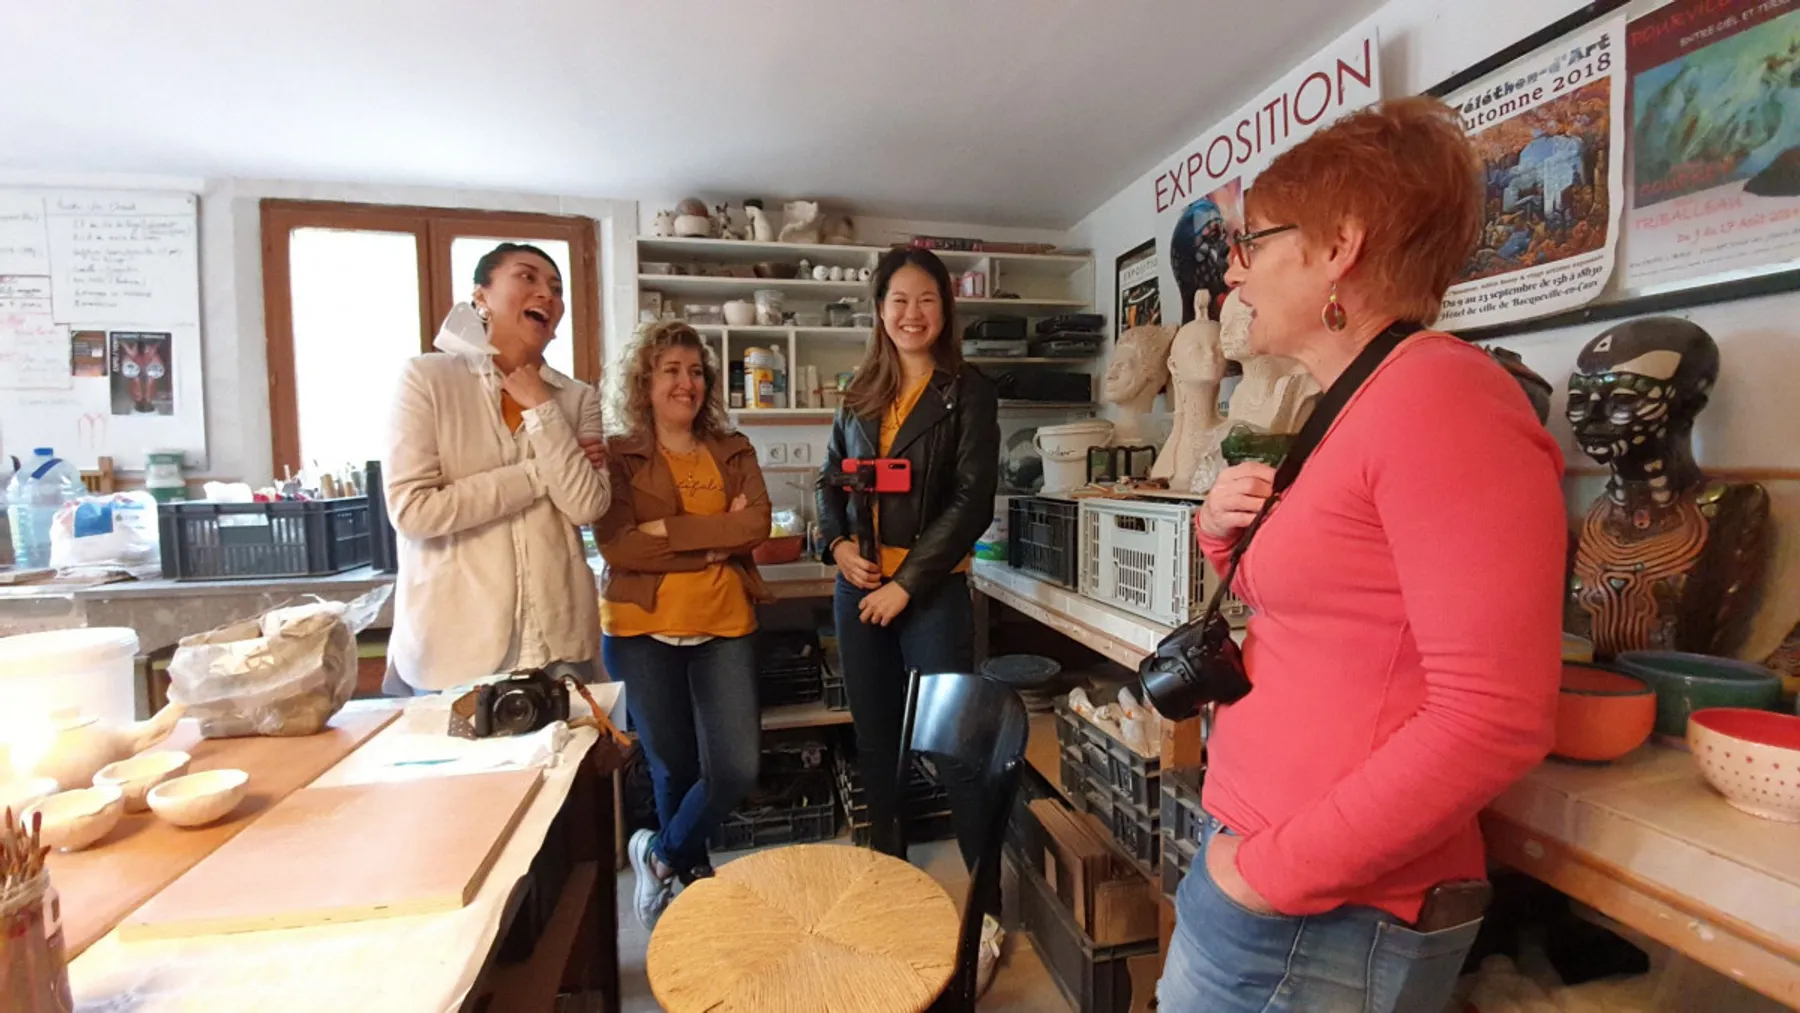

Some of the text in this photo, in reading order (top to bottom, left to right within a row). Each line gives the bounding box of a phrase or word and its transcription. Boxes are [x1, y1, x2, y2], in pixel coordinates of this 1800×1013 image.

[1463, 52, 1612, 132] utomne 2018
[1154, 38, 1371, 214] EXPOSITION
[1467, 307, 1477, 315] de
[1479, 303, 1496, 313] ville
[1499, 300, 1509, 309] de
[1478, 293, 1488, 302] 23
[1489, 283, 1538, 300] septembre
[1539, 278, 1550, 288] de
